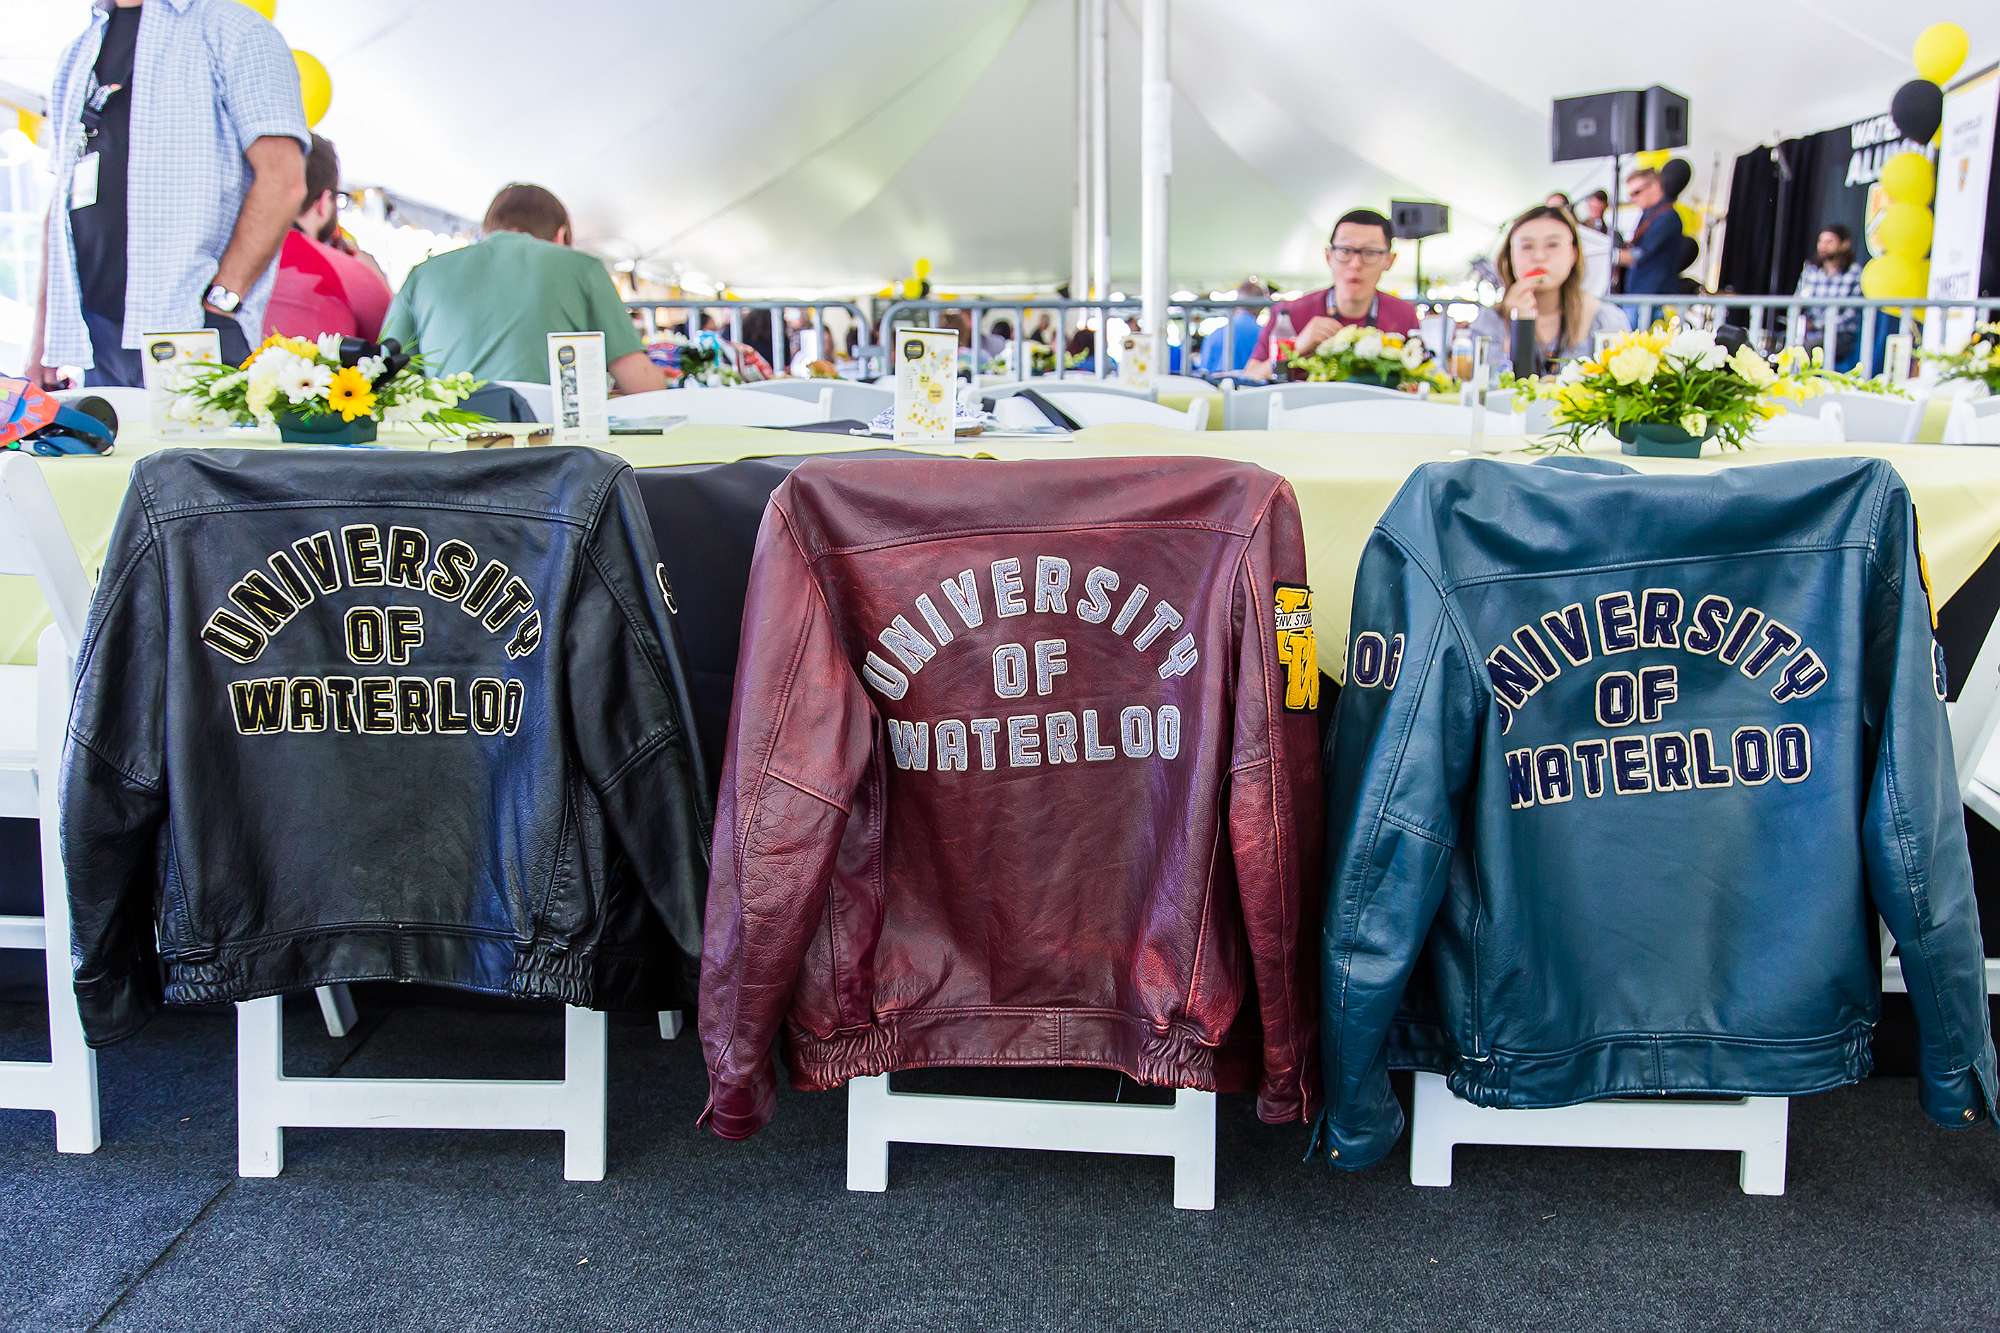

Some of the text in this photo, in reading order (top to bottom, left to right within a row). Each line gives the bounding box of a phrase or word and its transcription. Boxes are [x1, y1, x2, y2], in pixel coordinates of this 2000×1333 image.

[1851, 114, 1902, 150] WATE
[201, 523, 542, 665] UNIVERSITY
[344, 606, 425, 665] OF
[862, 555, 1198, 700] UNIVERSITY
[992, 638, 1067, 699] OF
[1594, 665, 1678, 728] OF
[227, 676, 525, 737] WATERLOO
[887, 704, 1182, 771] WATERLOO
